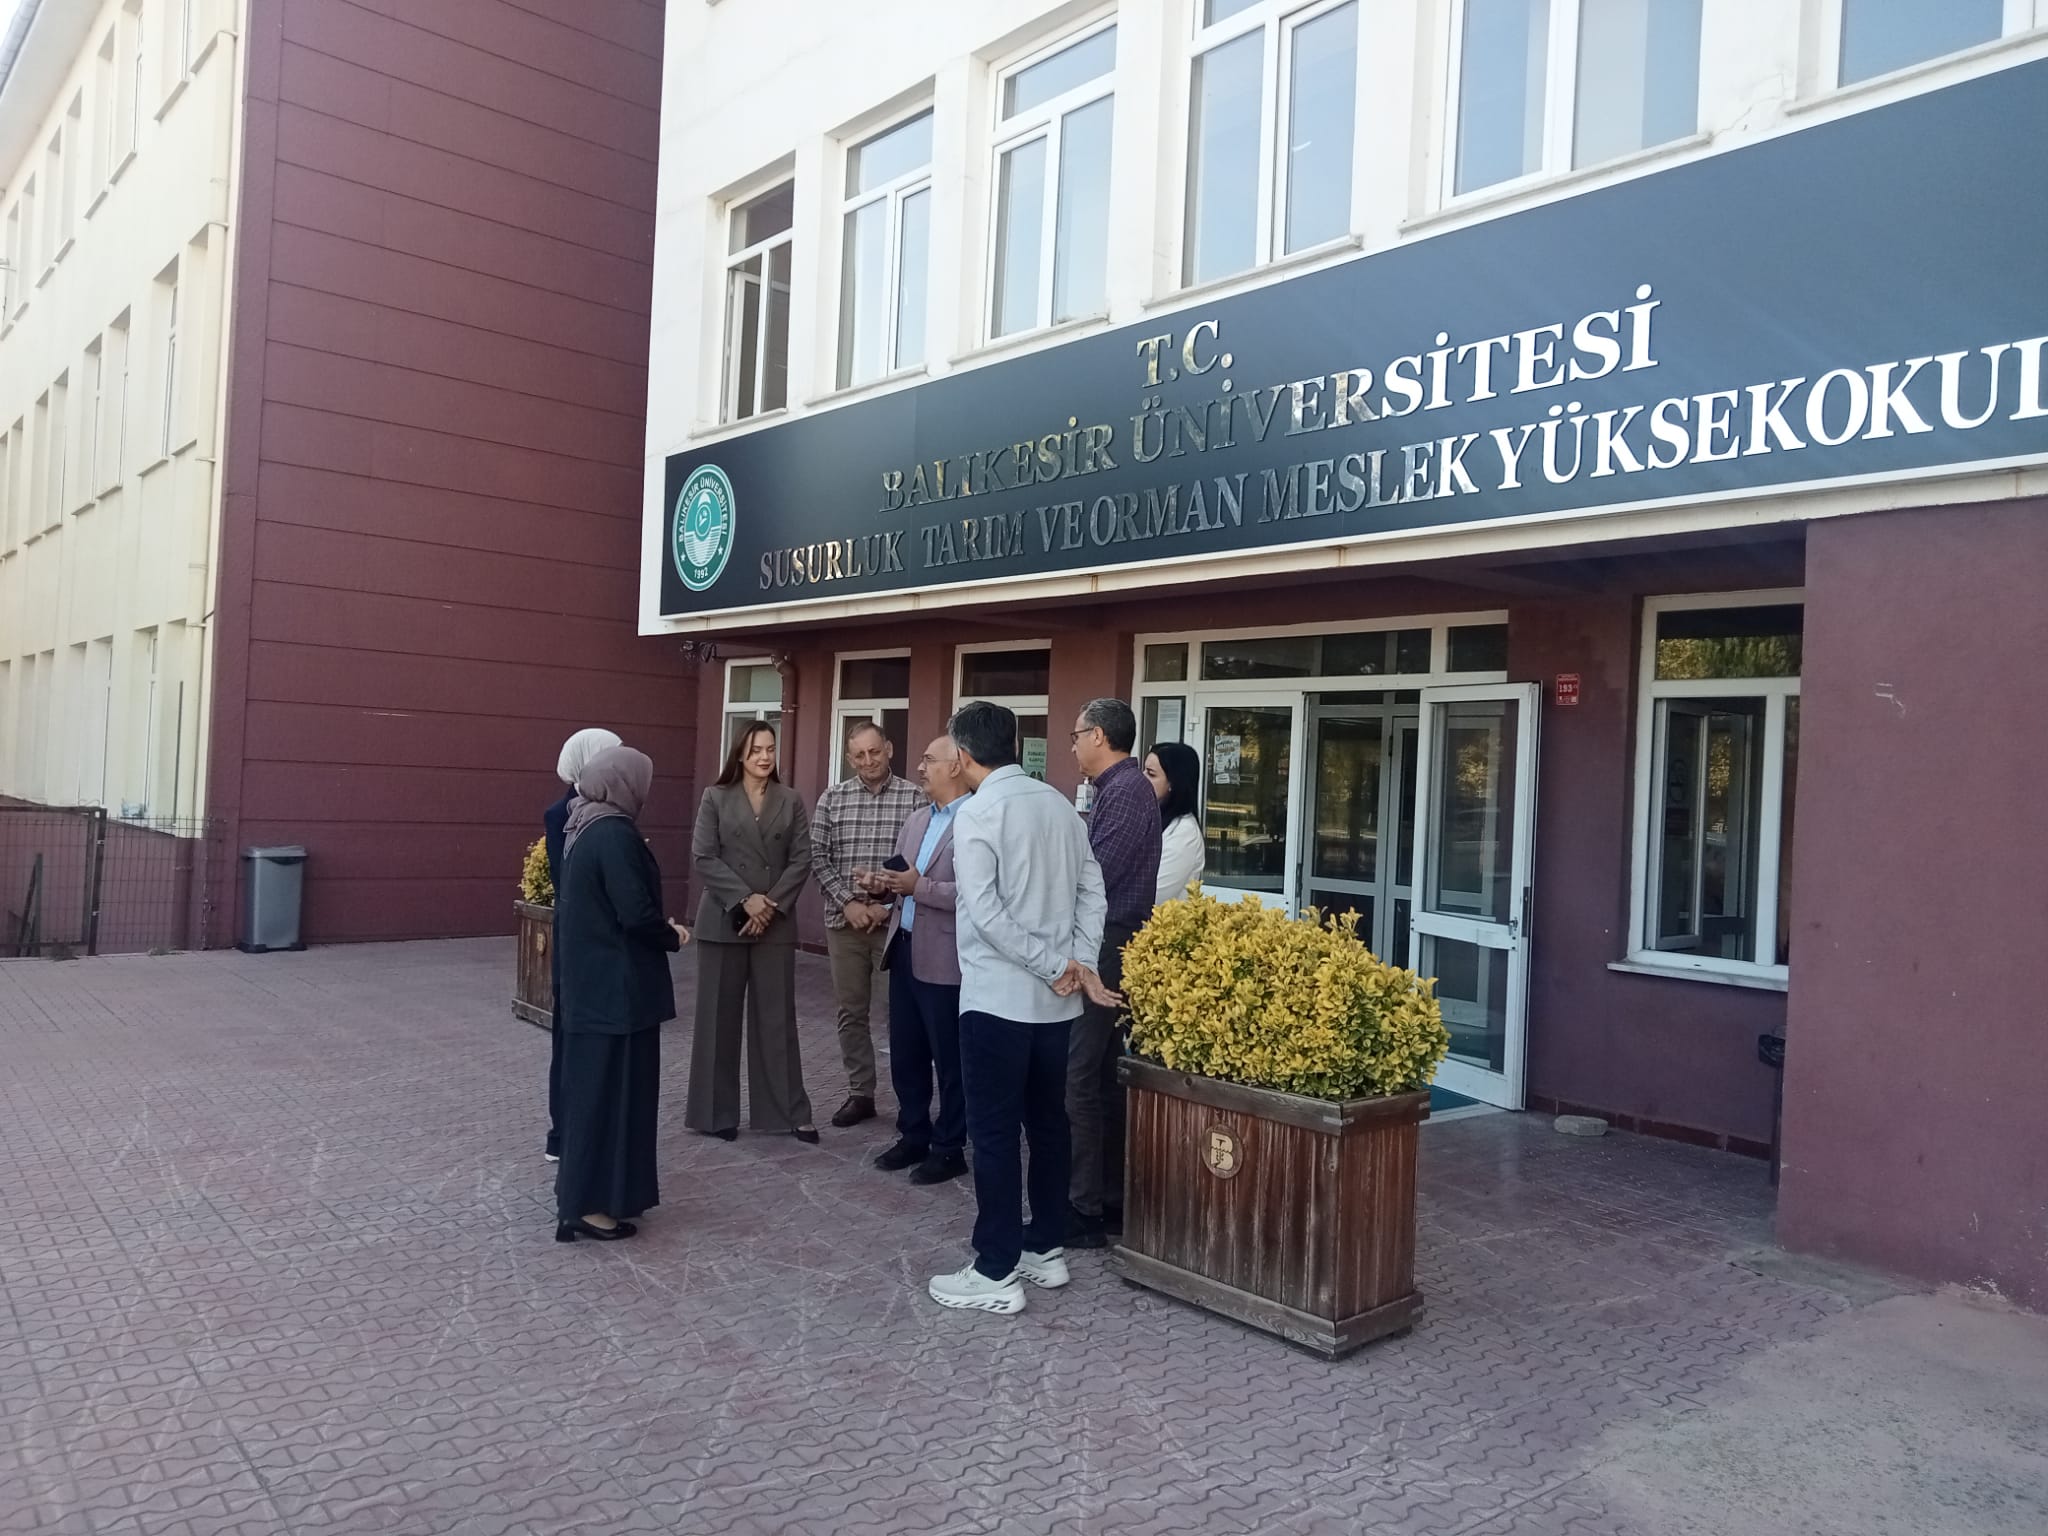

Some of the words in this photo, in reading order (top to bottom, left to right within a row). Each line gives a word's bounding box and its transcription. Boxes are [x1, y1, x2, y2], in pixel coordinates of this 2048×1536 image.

[879, 416, 1119, 512] BALIKESİR
[1130, 283, 1661, 463] ÜNİVERSİTESİ
[1136, 319, 1233, 388] T.C.
[759, 530, 904, 590] SUSURLUK
[921, 510, 1027, 568] TARIM
[1257, 432, 1480, 523] MESLEK
[694, 566, 709, 579] 1992
